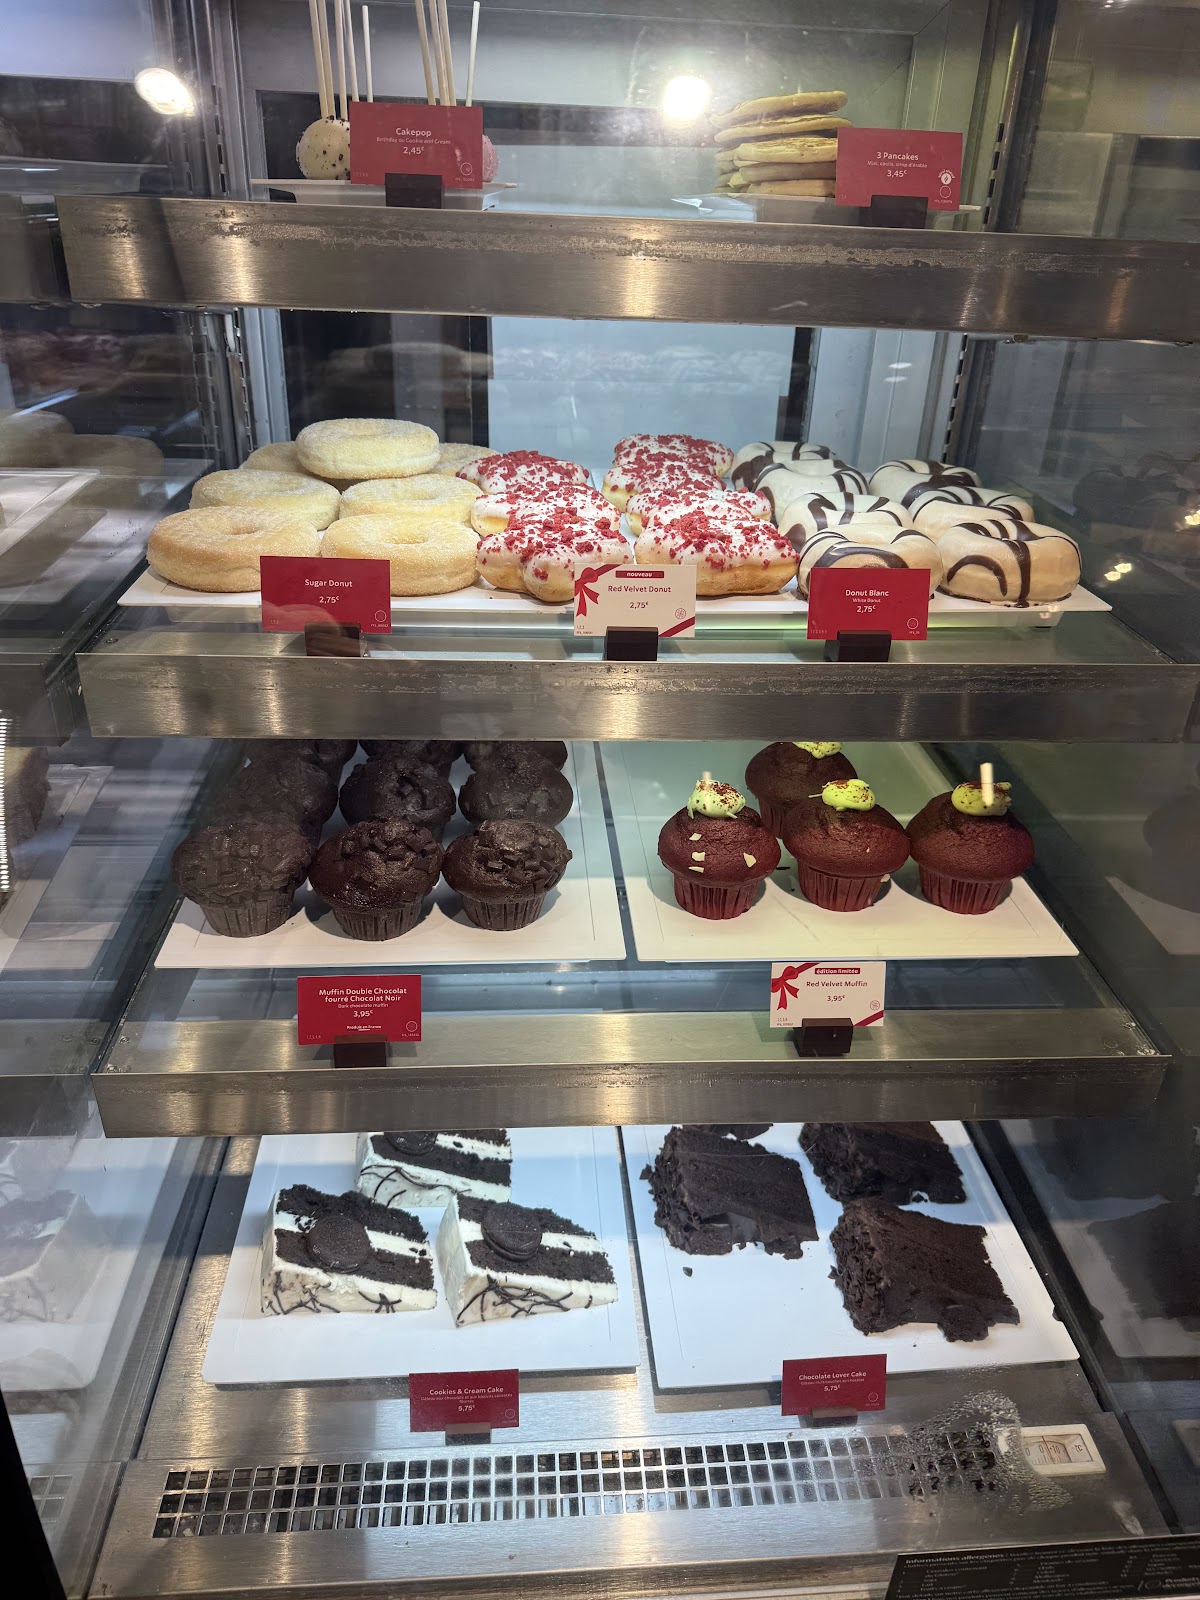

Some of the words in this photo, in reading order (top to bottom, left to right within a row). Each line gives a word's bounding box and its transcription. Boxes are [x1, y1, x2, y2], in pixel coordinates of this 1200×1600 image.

[396, 127, 432, 137] Cakepop
[884, 152, 919, 160] Pancakes
[304, 578, 327, 588] Sugar
